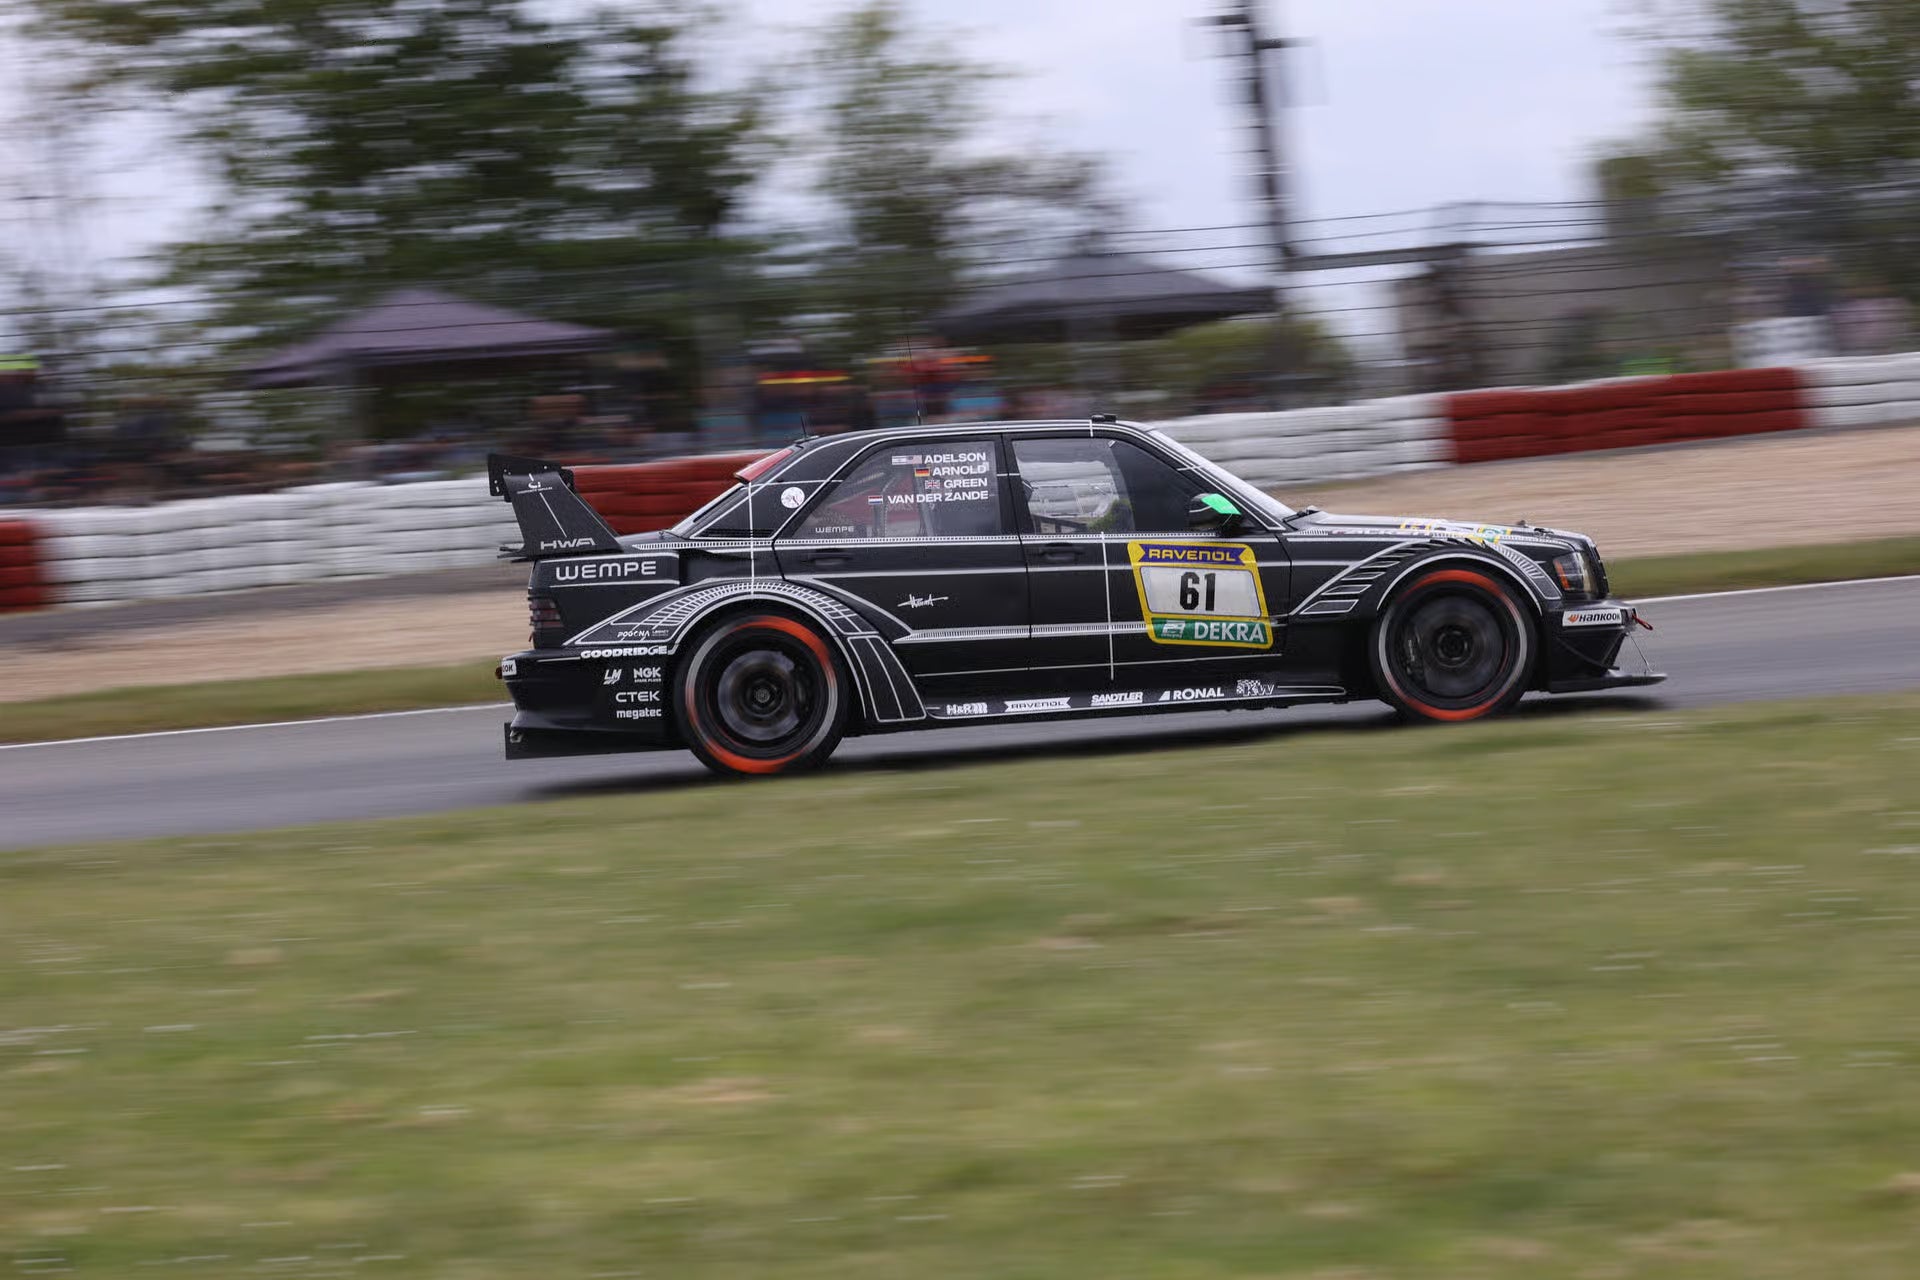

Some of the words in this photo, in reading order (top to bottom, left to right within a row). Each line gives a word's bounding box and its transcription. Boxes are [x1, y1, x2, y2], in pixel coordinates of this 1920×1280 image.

[924, 452, 986, 464] ADELSON
[932, 464, 986, 477] ARNOLD
[943, 478, 988, 489] GREEN
[887, 494, 915, 505] VAN
[916, 493, 943, 504] DER
[944, 491, 989, 501] ZANDE
[815, 525, 855, 533] WEMPE
[540, 537, 596, 550] HWA
[1148, 548, 1236, 562] RAVENOL
[556, 560, 657, 581] WEMPE
[1179, 571, 1216, 611] 61
[1194, 621, 1265, 643] DEKRA
[580, 645, 668, 659] GOODRIDGE
[633, 666, 661, 679] NGK
[615, 690, 660, 703] CTEK
[1091, 691, 1144, 704] SANDTLER
[1173, 687, 1225, 701] RONAL
[1011, 700, 1064, 710] RAVENOL
[616, 708, 662, 720] megatec
